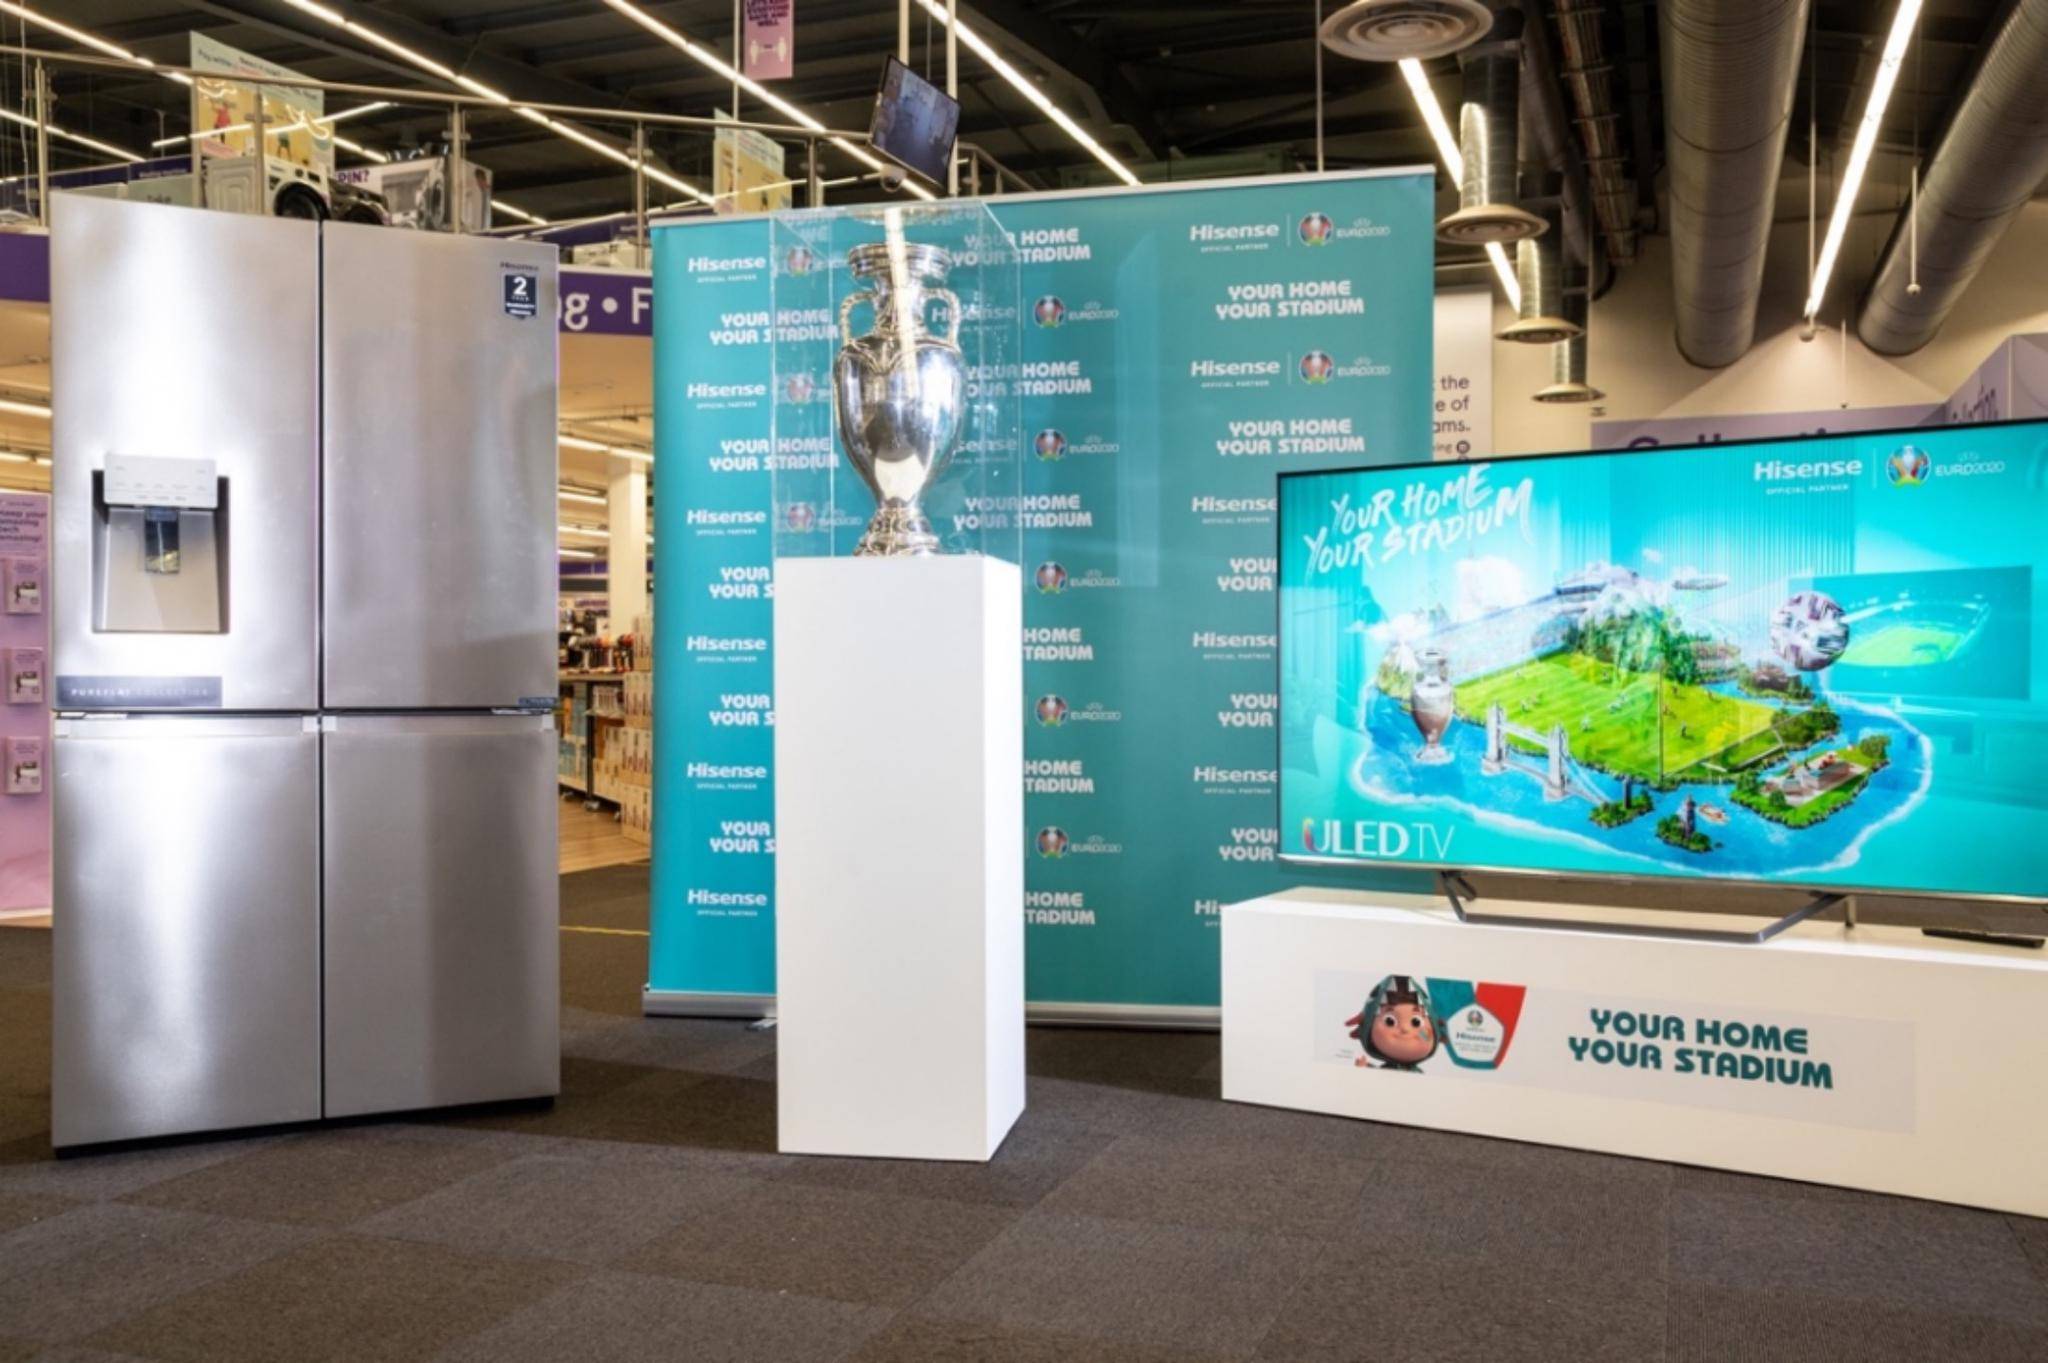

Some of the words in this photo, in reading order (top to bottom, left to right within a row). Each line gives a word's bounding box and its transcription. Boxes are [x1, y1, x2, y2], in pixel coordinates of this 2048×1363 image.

[1021, 228, 1079, 246] HOME
[1190, 224, 1280, 241] Hisense
[1337, 226, 1391, 238] EURO2020
[688, 256, 766, 273] Hisense
[953, 250, 1006, 267] YOUR
[1012, 245, 1092, 264] STADIUM
[513, 276, 528, 296] 2
[1228, 283, 1284, 301] YOUR
[1289, 280, 1352, 298] HOME
[1216, 303, 1271, 320] YOUR
[1277, 297, 1365, 318] STADIUM
[721, 311, 770, 328] YOUR
[777, 309, 832, 326] HOME
[709, 328, 760, 346] YOUR
[763, 324, 840, 343] STADIUM
[1022, 361, 1080, 378] HOME
[1191, 359, 1280, 377] Hisense
[1338, 365, 1391, 376] EURO2020
[687, 383, 767, 399] Hisense
[967, 382, 1007, 398] OUR
[1012, 377, 1092, 396] STADIUM
[1440, 375, 1470, 390] the
[1451, 394, 1470, 411] of
[1229, 421, 1284, 437] YOUR
[1290, 418, 1352, 435] HOME
[1433, 419, 1471, 434] ams.
[720, 438, 769, 454] YOUR
[777, 436, 832, 452] HOME
[1217, 440, 1271, 456] YOUR
[1278, 436, 1365, 454] STADIUM
[709, 456, 760, 472] YOUR
[763, 453, 840, 470] STADIUM
[1754, 459, 1863, 481] Hisense
[1935, 461, 2006, 476] EURO2020
[1402, 463, 1494, 518] HOME
[1766, 487, 1805, 496] OFFICIAL
[1808, 483, 1849, 493] PARTNER
[965, 497, 1020, 512] YOUR
[1023, 494, 1081, 512] HOME
[687, 509, 767, 525] Hisense
[953, 514, 1008, 532] YOUR
[1013, 511, 1093, 529] STADIUM
[1303, 526, 1375, 584] YOUR
[1380, 478, 1536, 563] STADIUM
[720, 566, 770, 582] YOUR
[709, 583, 760, 600] YOUR
[1218, 575, 1273, 592] YOUR
[1023, 627, 1082, 643] HOME
[687, 636, 767, 652] Hisense
[1023, 645, 1094, 661] TADIUM
[721, 694, 770, 709] YOUR
[709, 711, 760, 726] YOUR
[1218, 712, 1274, 728] YOUR
[687, 762, 767, 778] Hisense
[1024, 760, 1083, 775] HOME
[1024, 777, 1095, 793] TADIUM
[720, 820, 771, 837] YOUR
[709, 837, 760, 854] YOUR
[1303, 818, 1410, 857] ULED
[1411, 822, 1455, 860] TV
[1219, 846, 1275, 862] YOUR
[687, 889, 768, 906] Hisense
[1025, 892, 1084, 908] HOME
[1025, 908, 1096, 925] TADIUM
[1590, 1008, 1686, 1043] YOUR
[1695, 1017, 1809, 1055] HOME
[1568, 1036, 1662, 1071] YOUR
[1674, 1047, 1834, 1090] STADIUM
